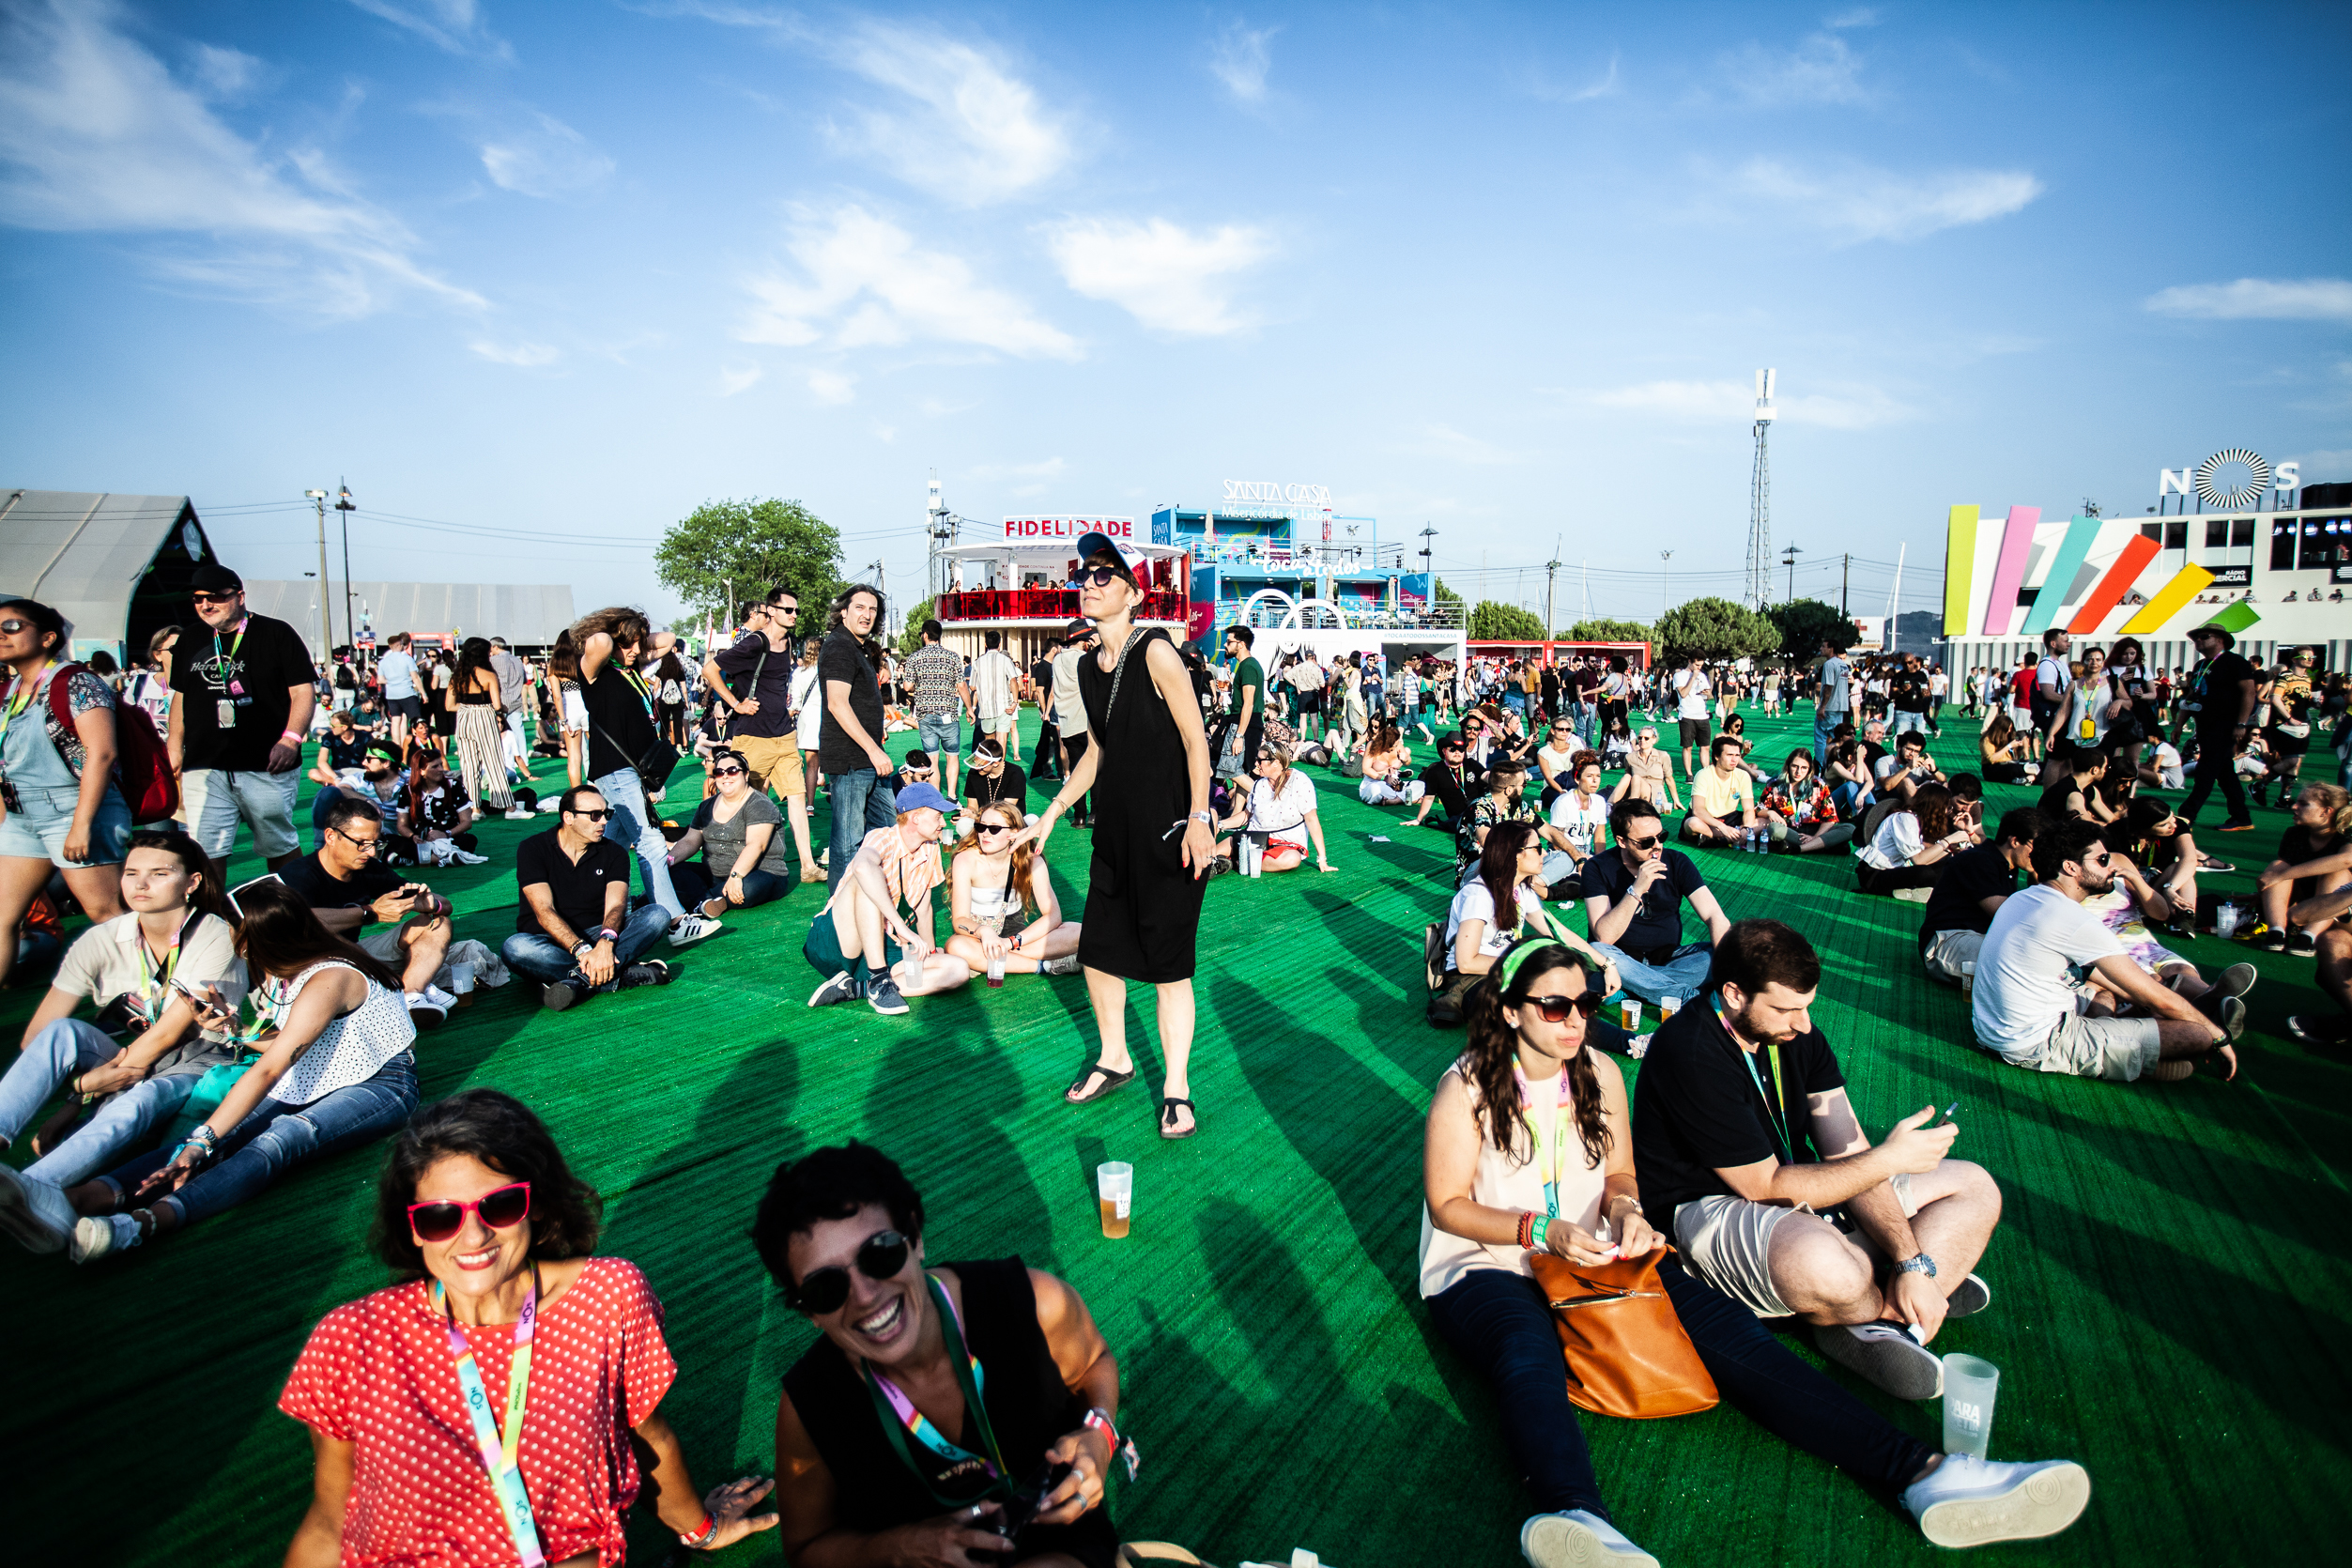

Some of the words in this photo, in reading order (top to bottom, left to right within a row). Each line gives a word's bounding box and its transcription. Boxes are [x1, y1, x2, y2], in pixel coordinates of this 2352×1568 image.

[2160, 448, 2299, 508] NOS
[1222, 479, 1283, 502] SANTA
[1285, 484, 1332, 505] CASA
[1222, 505, 1284, 519] Misericórdia
[1286, 508, 1298, 520] de
[1301, 509, 1332, 521] Lisboa
[1006, 519, 1132, 536] FIDELIDADE
[1153, 522, 1169, 537] SANTA
[191, 661, 219, 672] Hard
[522, 1301, 534, 1325] NOS
[469, 1386, 484, 1410] NOS
[515, 1499, 529, 1526] NOS
